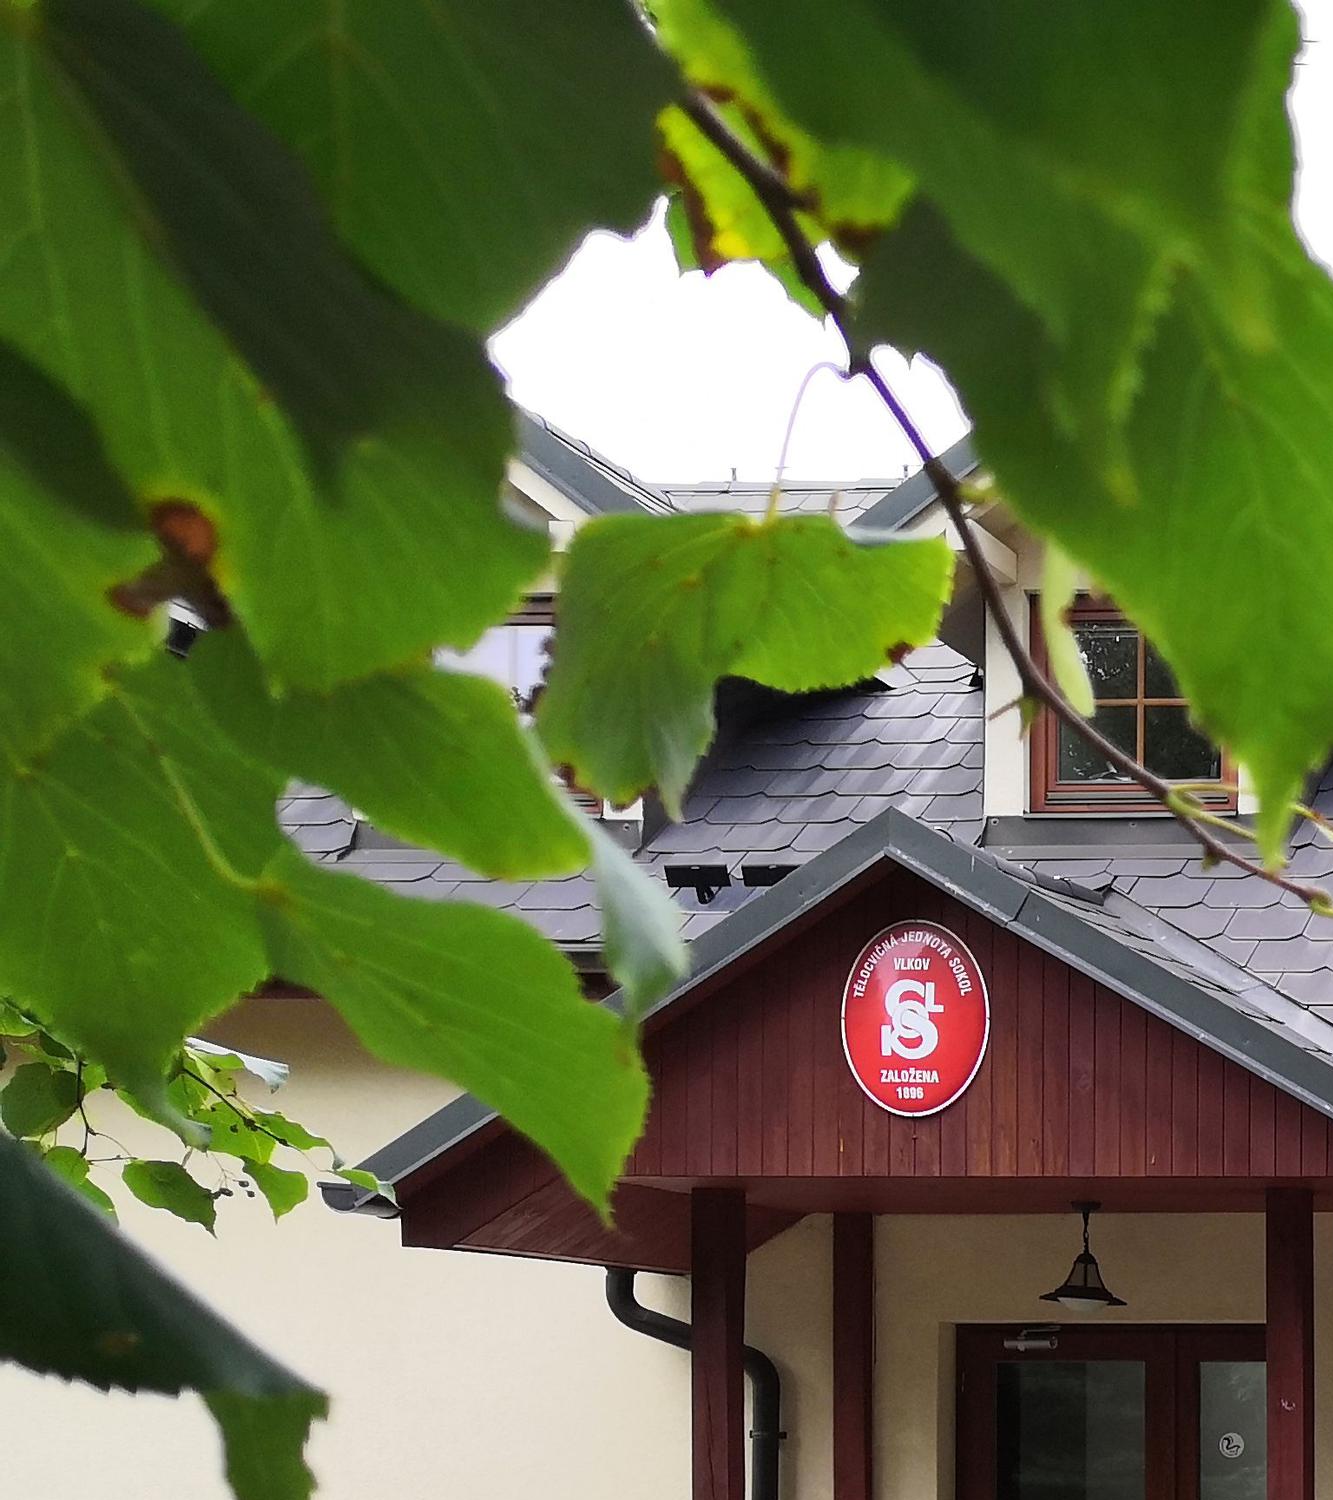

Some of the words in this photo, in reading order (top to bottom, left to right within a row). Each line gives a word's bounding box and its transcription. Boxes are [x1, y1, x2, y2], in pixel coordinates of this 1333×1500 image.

[853, 933, 899, 998] TĚLOCVIČNÁ
[901, 930, 952, 959] JEDNOTA
[948, 957, 973, 997] SOKOL
[893, 957, 931, 971] VLKOV
[880, 1067, 940, 1083] ZALOŽENA
